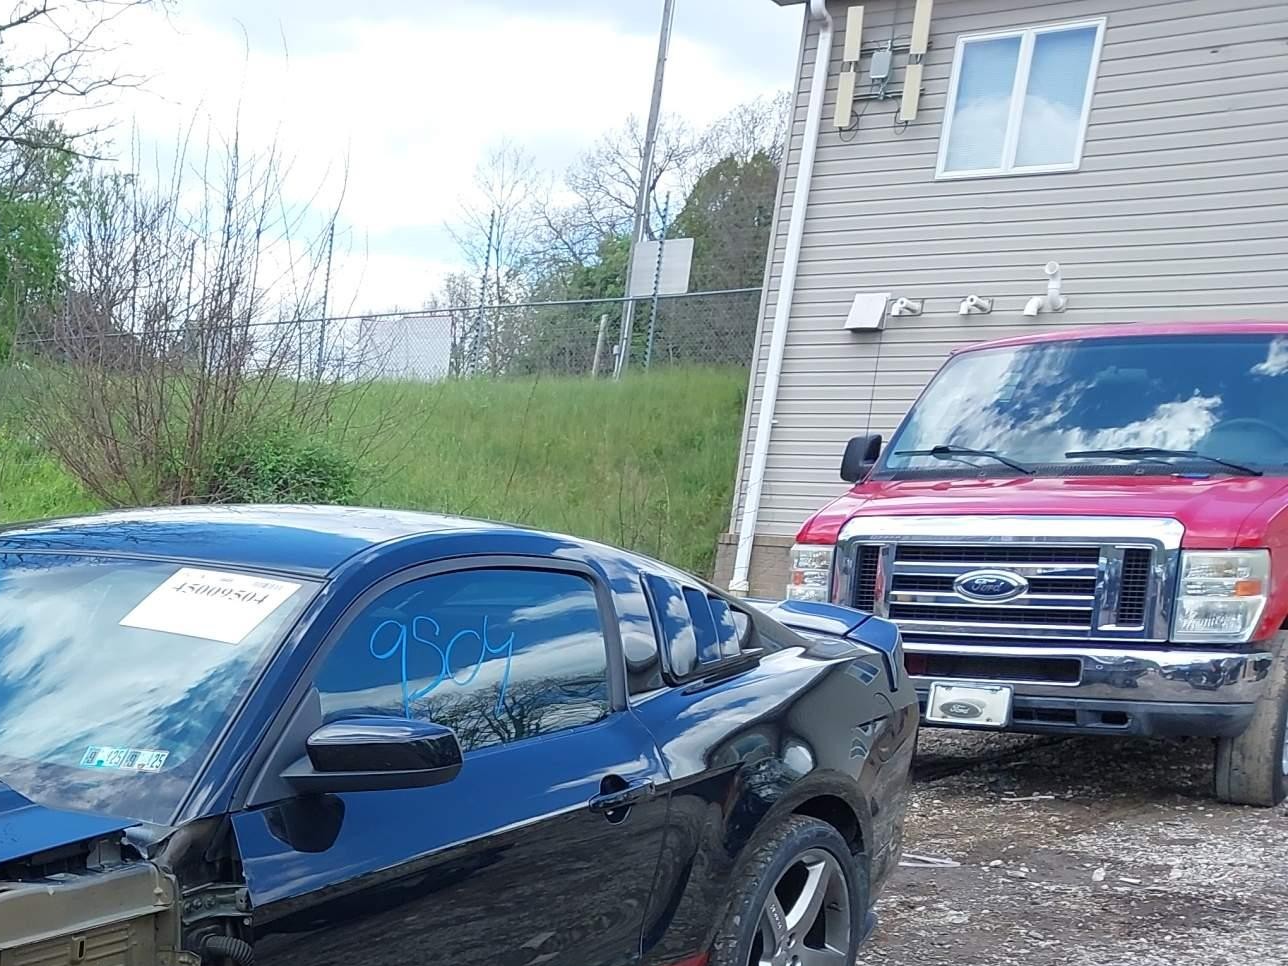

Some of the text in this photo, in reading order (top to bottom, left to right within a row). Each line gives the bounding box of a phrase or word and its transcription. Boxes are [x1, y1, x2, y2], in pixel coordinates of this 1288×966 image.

[972, 577, 1005, 592] Ford
[173, 582, 270, 605] 45009504
[950, 703, 970, 715] Ford
